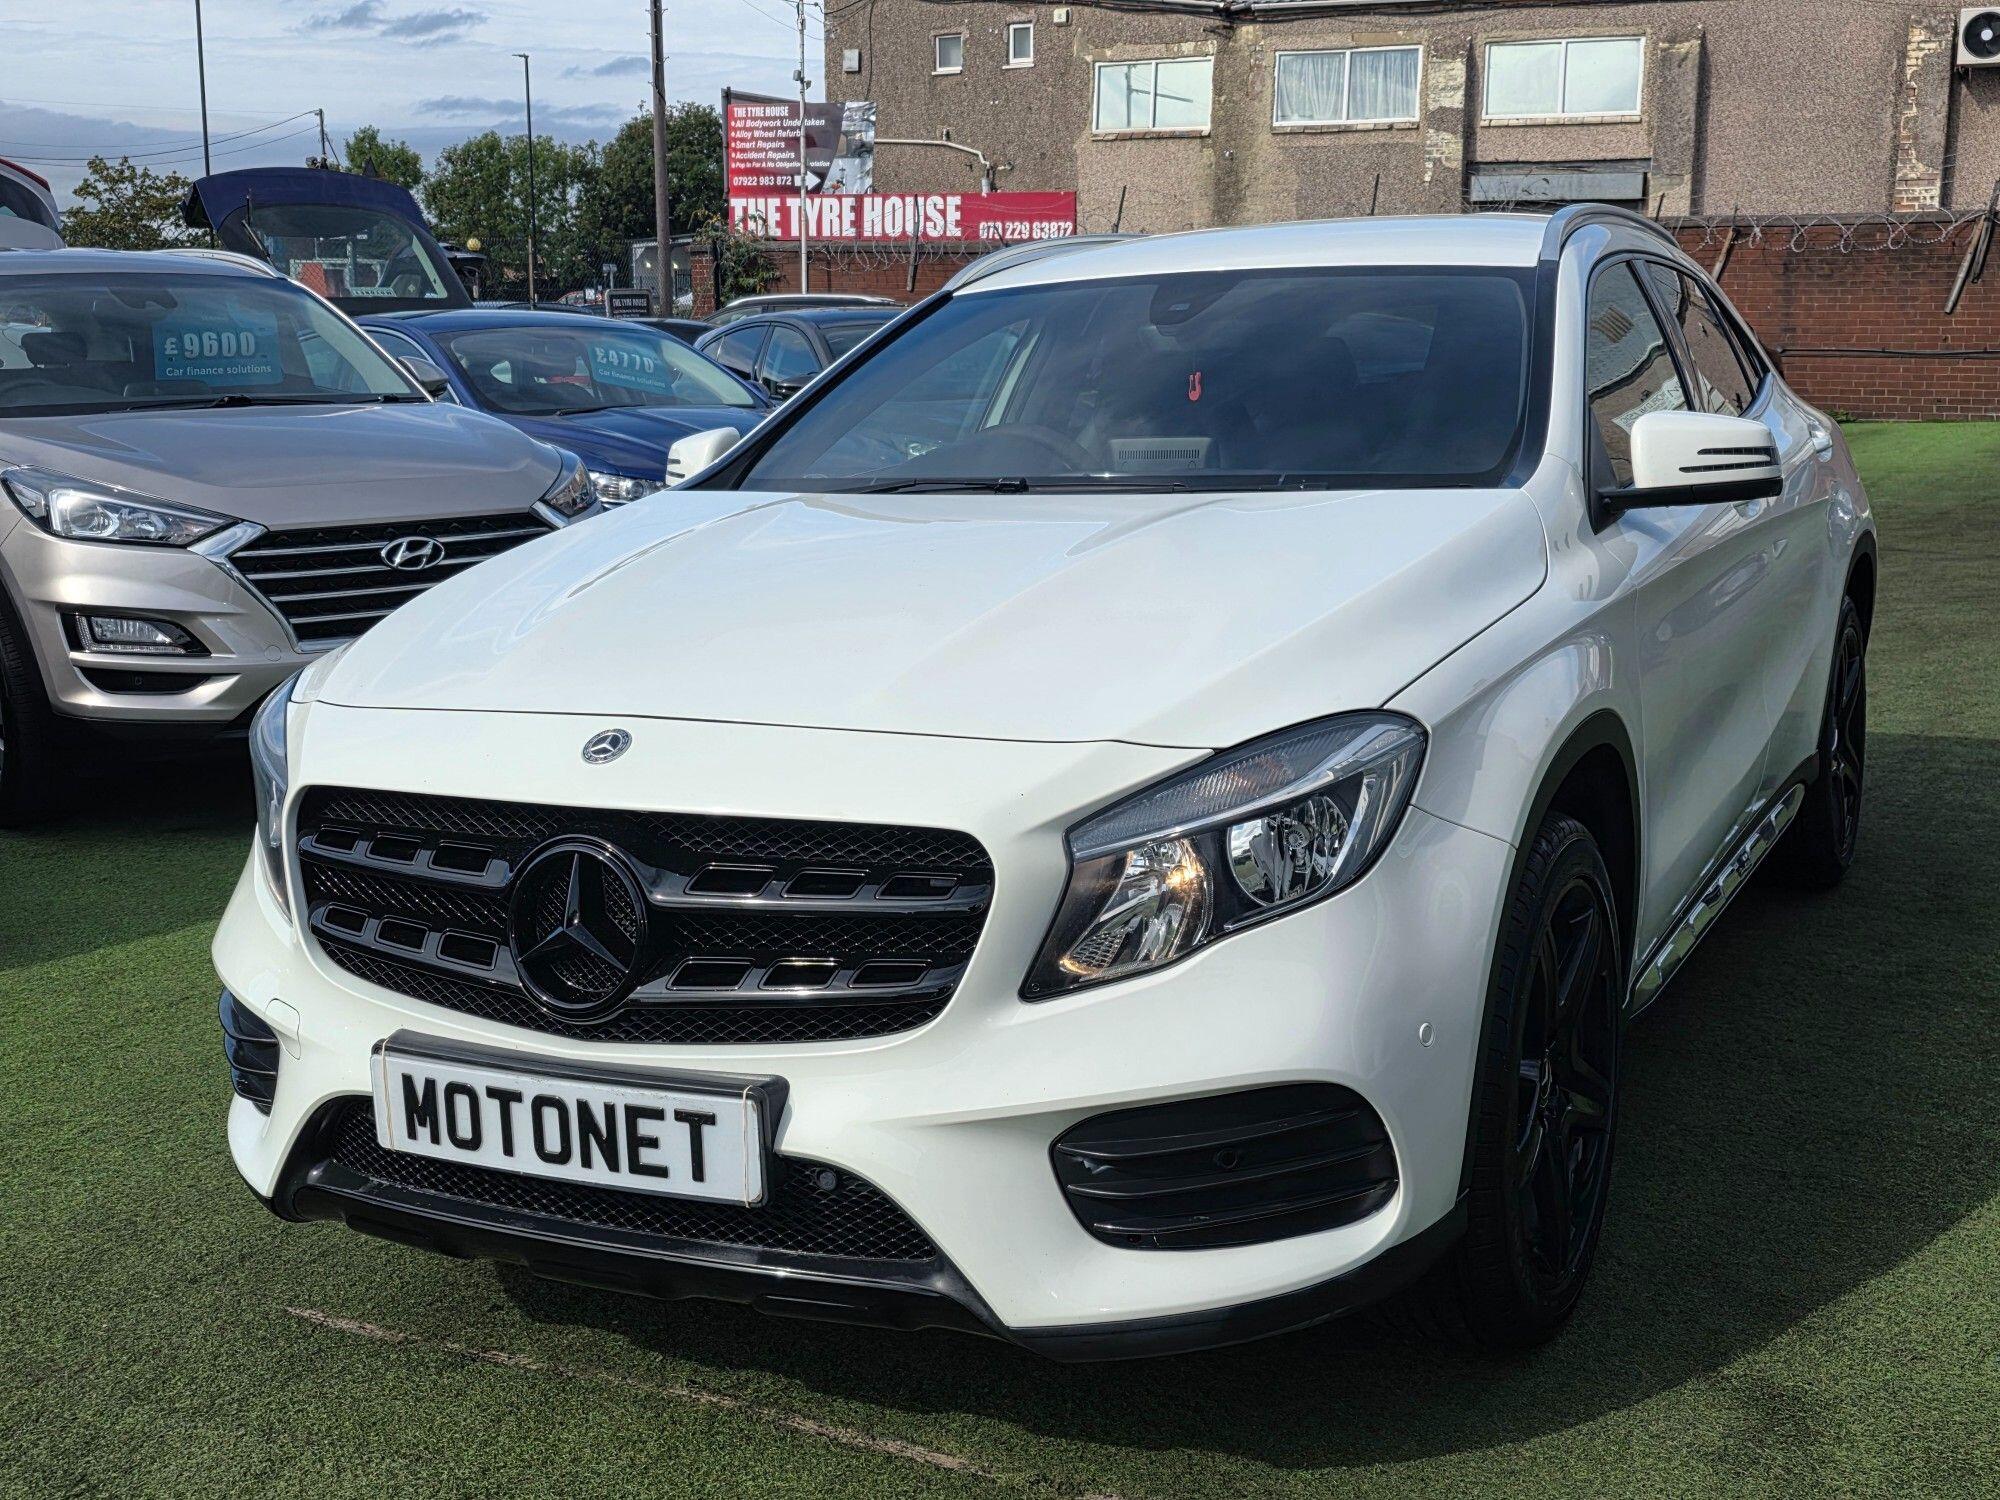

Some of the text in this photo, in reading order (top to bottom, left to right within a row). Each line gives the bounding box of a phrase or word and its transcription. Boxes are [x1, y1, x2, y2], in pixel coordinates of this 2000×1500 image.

[733, 105, 789, 117] THE TYRE HOUSE
[735, 118, 825, 129] All Bodywork Undetaken
[735, 130, 752, 140] Alloy
[753, 130, 776, 138] Wheel
[735, 140, 785, 150] Smart Repairs
[735, 151, 796, 160] Accident Repairs
[733, 176, 792, 186] 07922 983 872
[731, 196, 962, 237] THE TYRE HOUSE
[1004, 221, 1030, 239] 229
[166, 363, 272, 377] Car finance solutions
[401, 1072, 717, 1183] MOTONET
